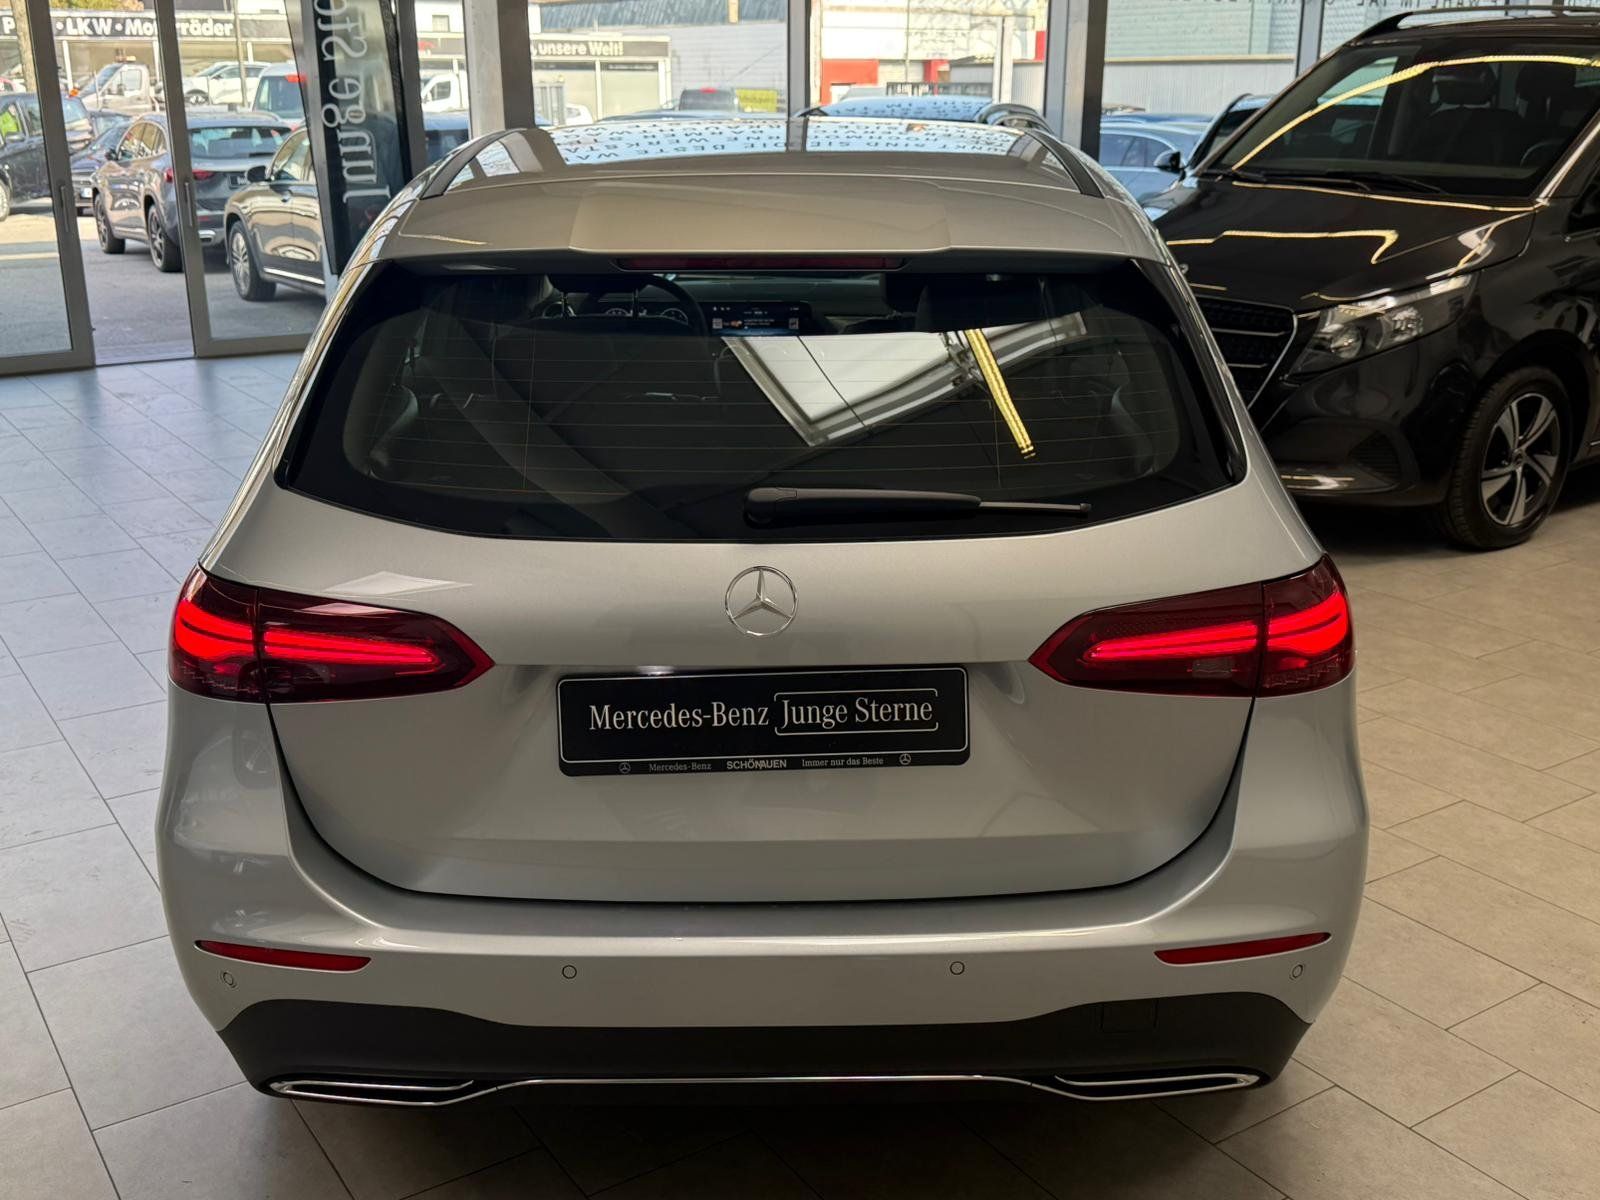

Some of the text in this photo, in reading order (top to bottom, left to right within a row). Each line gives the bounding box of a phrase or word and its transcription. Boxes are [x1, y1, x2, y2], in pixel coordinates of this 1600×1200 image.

[66, 17, 113, 36] LKW
[538, 42, 587, 56] unsere
[588, 41, 624, 56] Welt!
[589, 697, 933, 730] Mercedes-Benz Junge Sterne
[648, 762, 712, 773] Mercedes-Benz
[802, 759, 829, 768] Immer
[831, 758, 845, 766] nur
[847, 757, 861, 766] das
[863, 756, 884, 765] Beste
